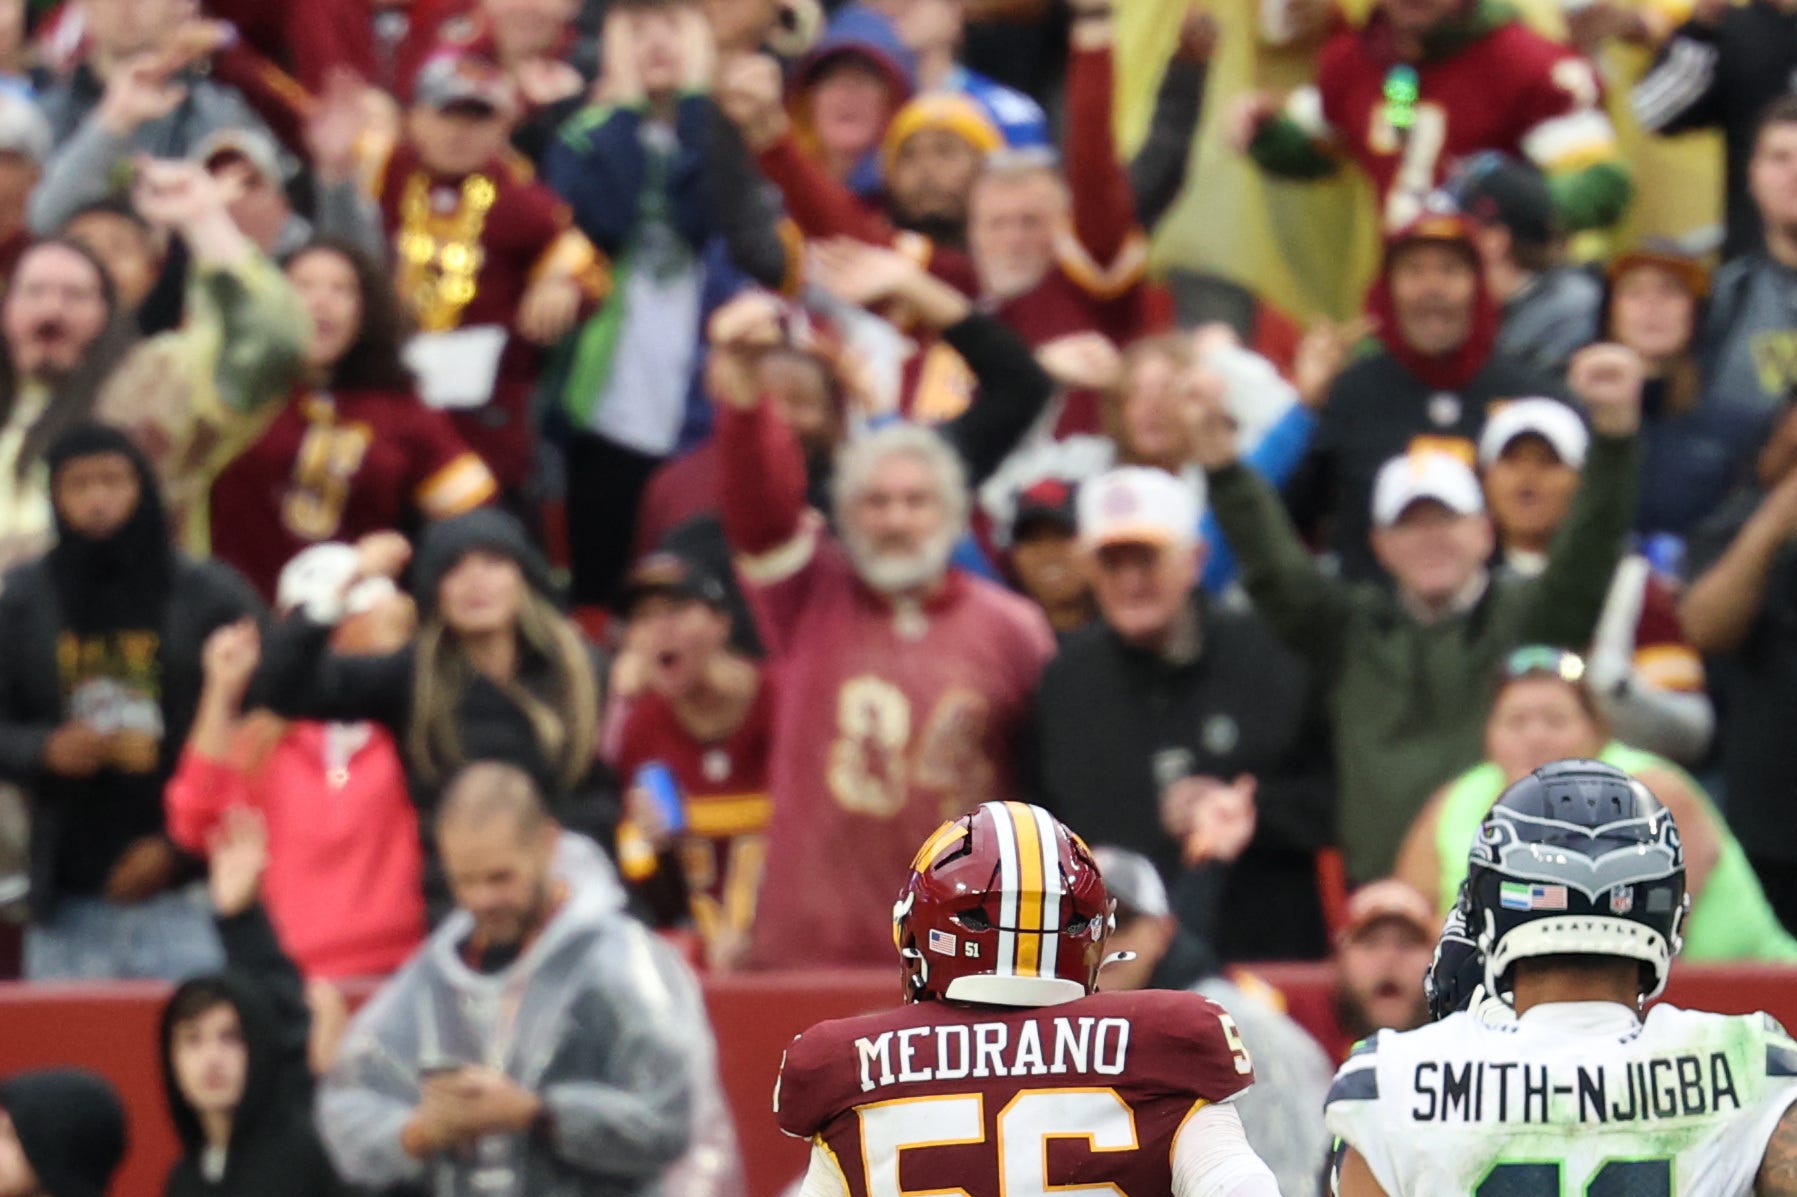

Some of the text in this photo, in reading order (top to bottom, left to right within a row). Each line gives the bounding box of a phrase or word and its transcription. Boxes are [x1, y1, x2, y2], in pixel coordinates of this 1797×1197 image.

[963, 941, 981, 958] 51
[1541, 920, 1638, 937] SEATTLE
[853, 1016, 1131, 1093] MEDRANO
[1217, 1011, 1253, 1075] 5
[1412, 1051, 1742, 1123] SMITH-NJIGBA
